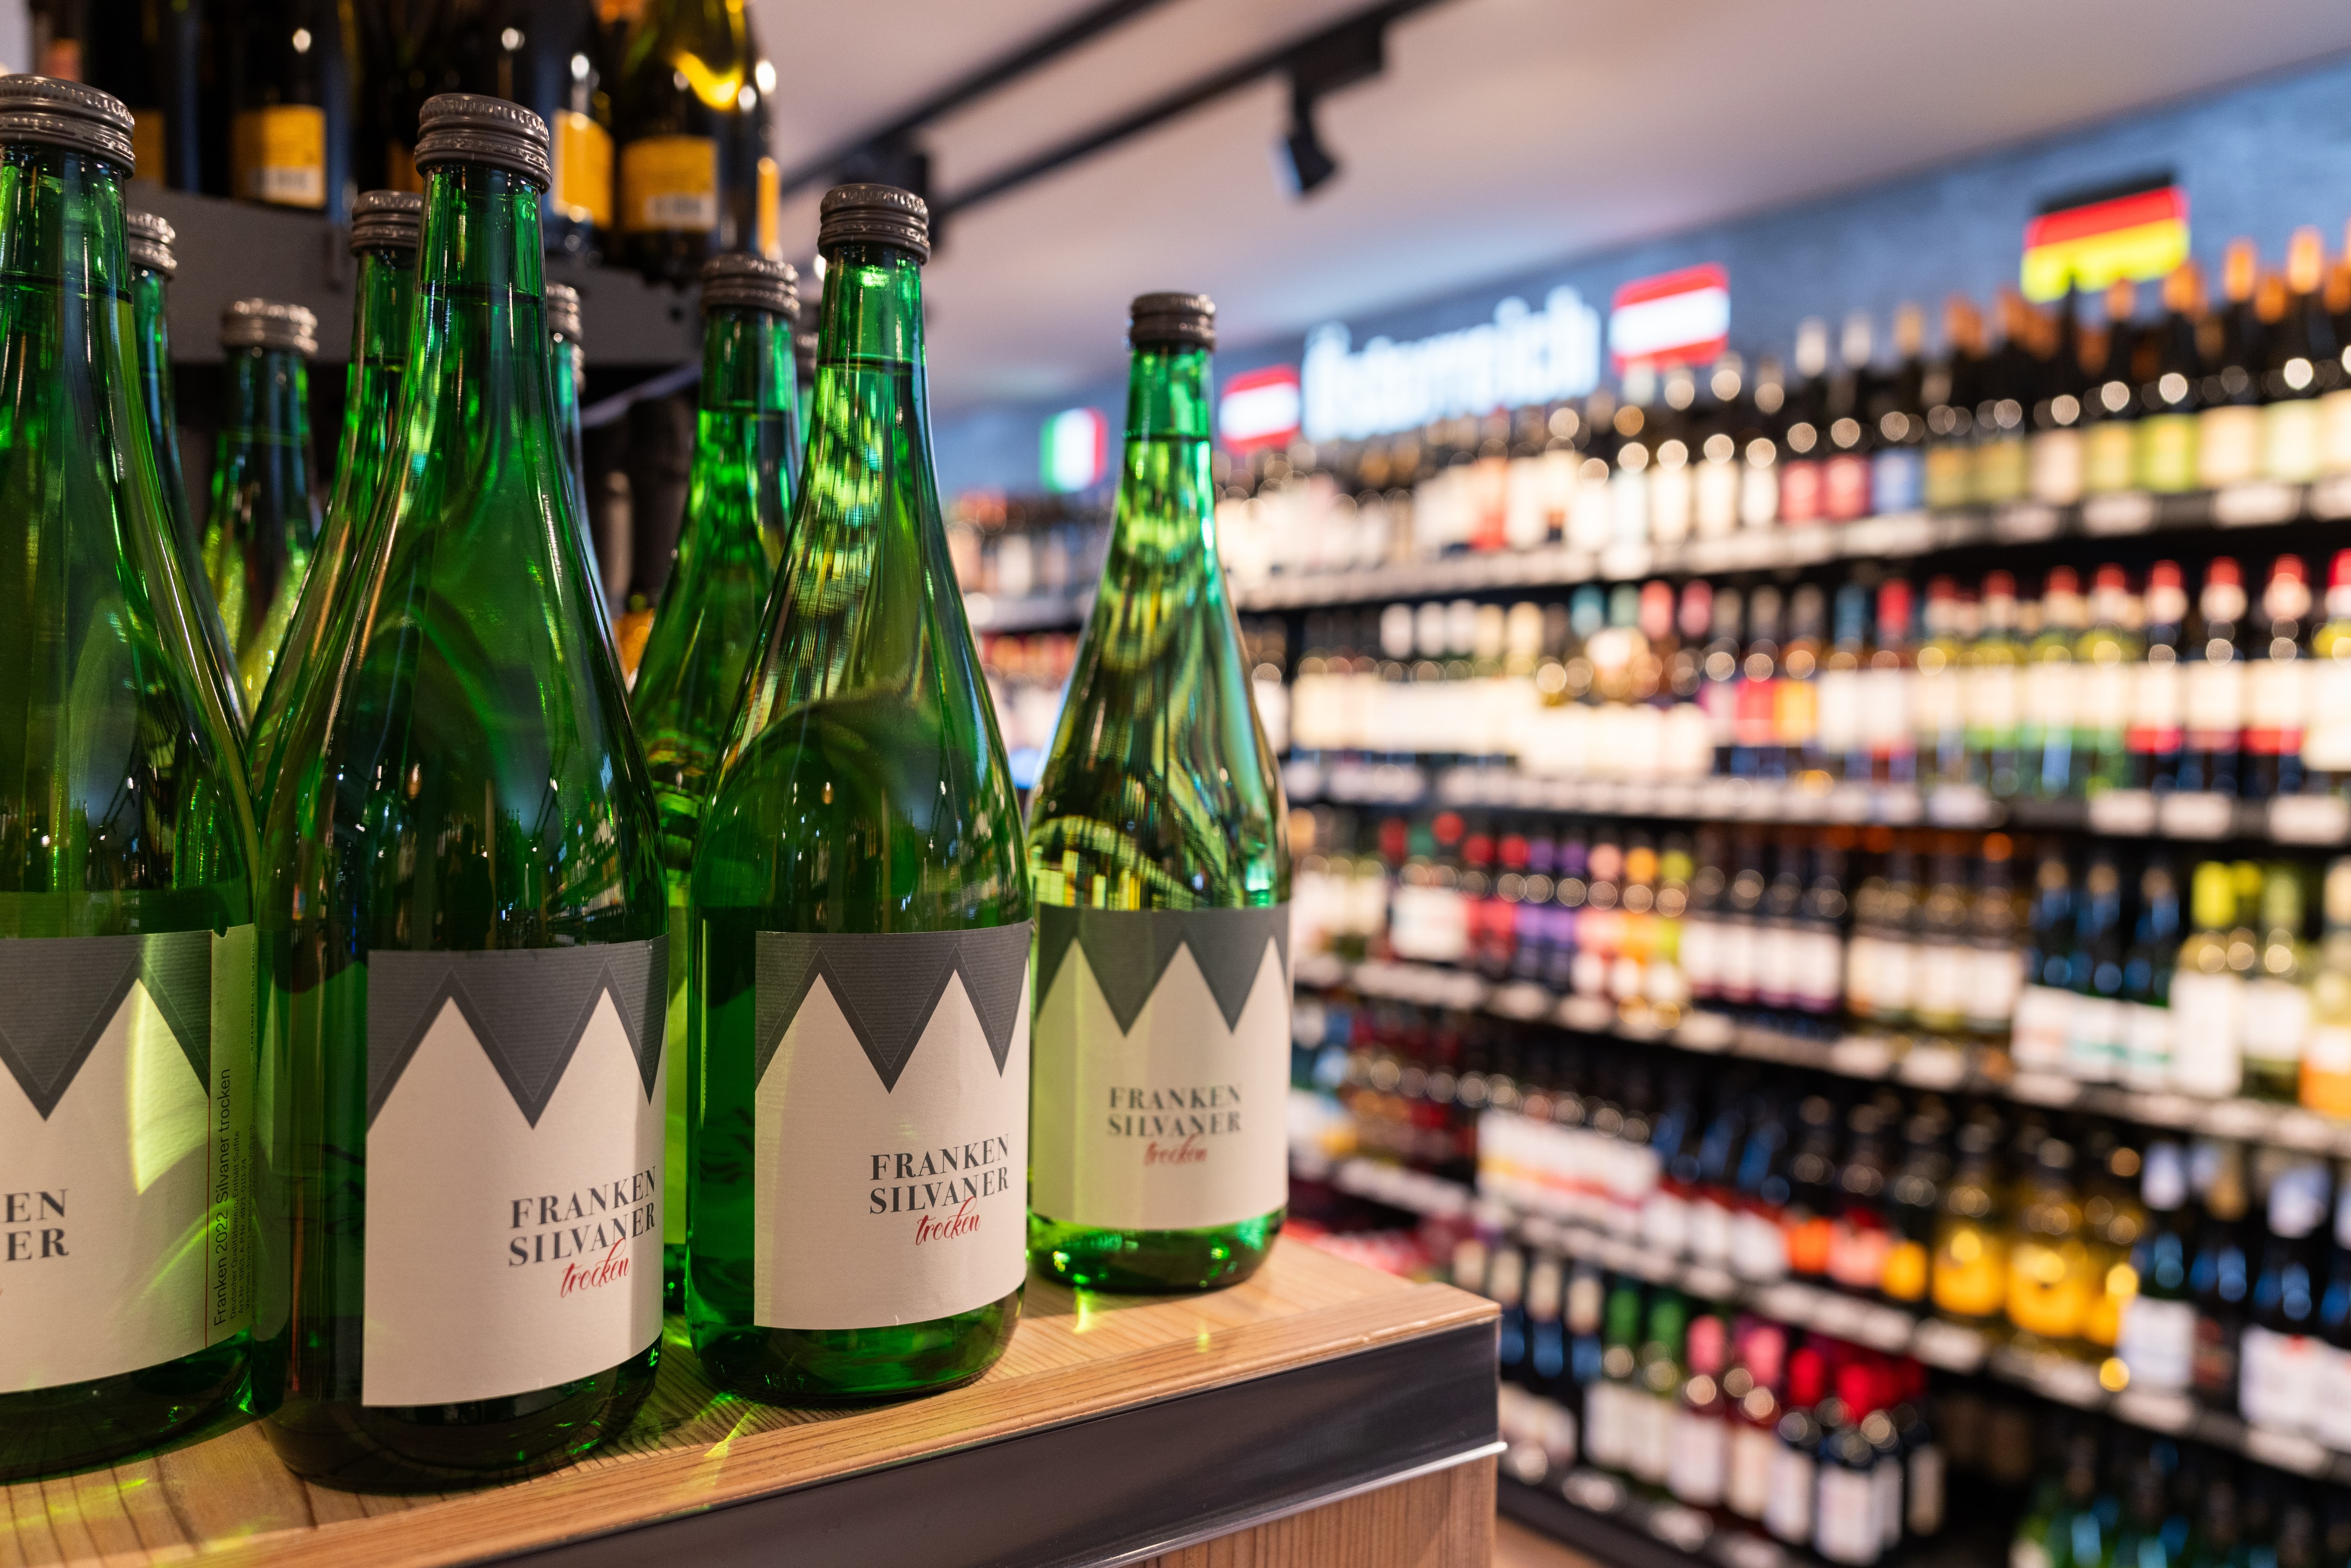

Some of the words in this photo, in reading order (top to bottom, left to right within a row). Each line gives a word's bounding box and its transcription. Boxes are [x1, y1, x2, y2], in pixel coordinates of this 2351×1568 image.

[217, 1069, 230, 1133] trocken
[1110, 1083, 1242, 1109] FRANKEN
[1107, 1111, 1240, 1137] SILVANER
[215, 1137, 229, 1204] Silvaner
[870, 1133, 1009, 1181] FRANKEN
[511, 1166, 656, 1229] FRANKEN
[869, 1166, 1009, 1214] SILVANER
[215, 1210, 228, 1253] 2022
[508, 1202, 655, 1267] SILVANER
[915, 1196, 981, 1245] trocken
[214, 1257, 227, 1326] Franken
[560, 1237, 631, 1298] trocken
